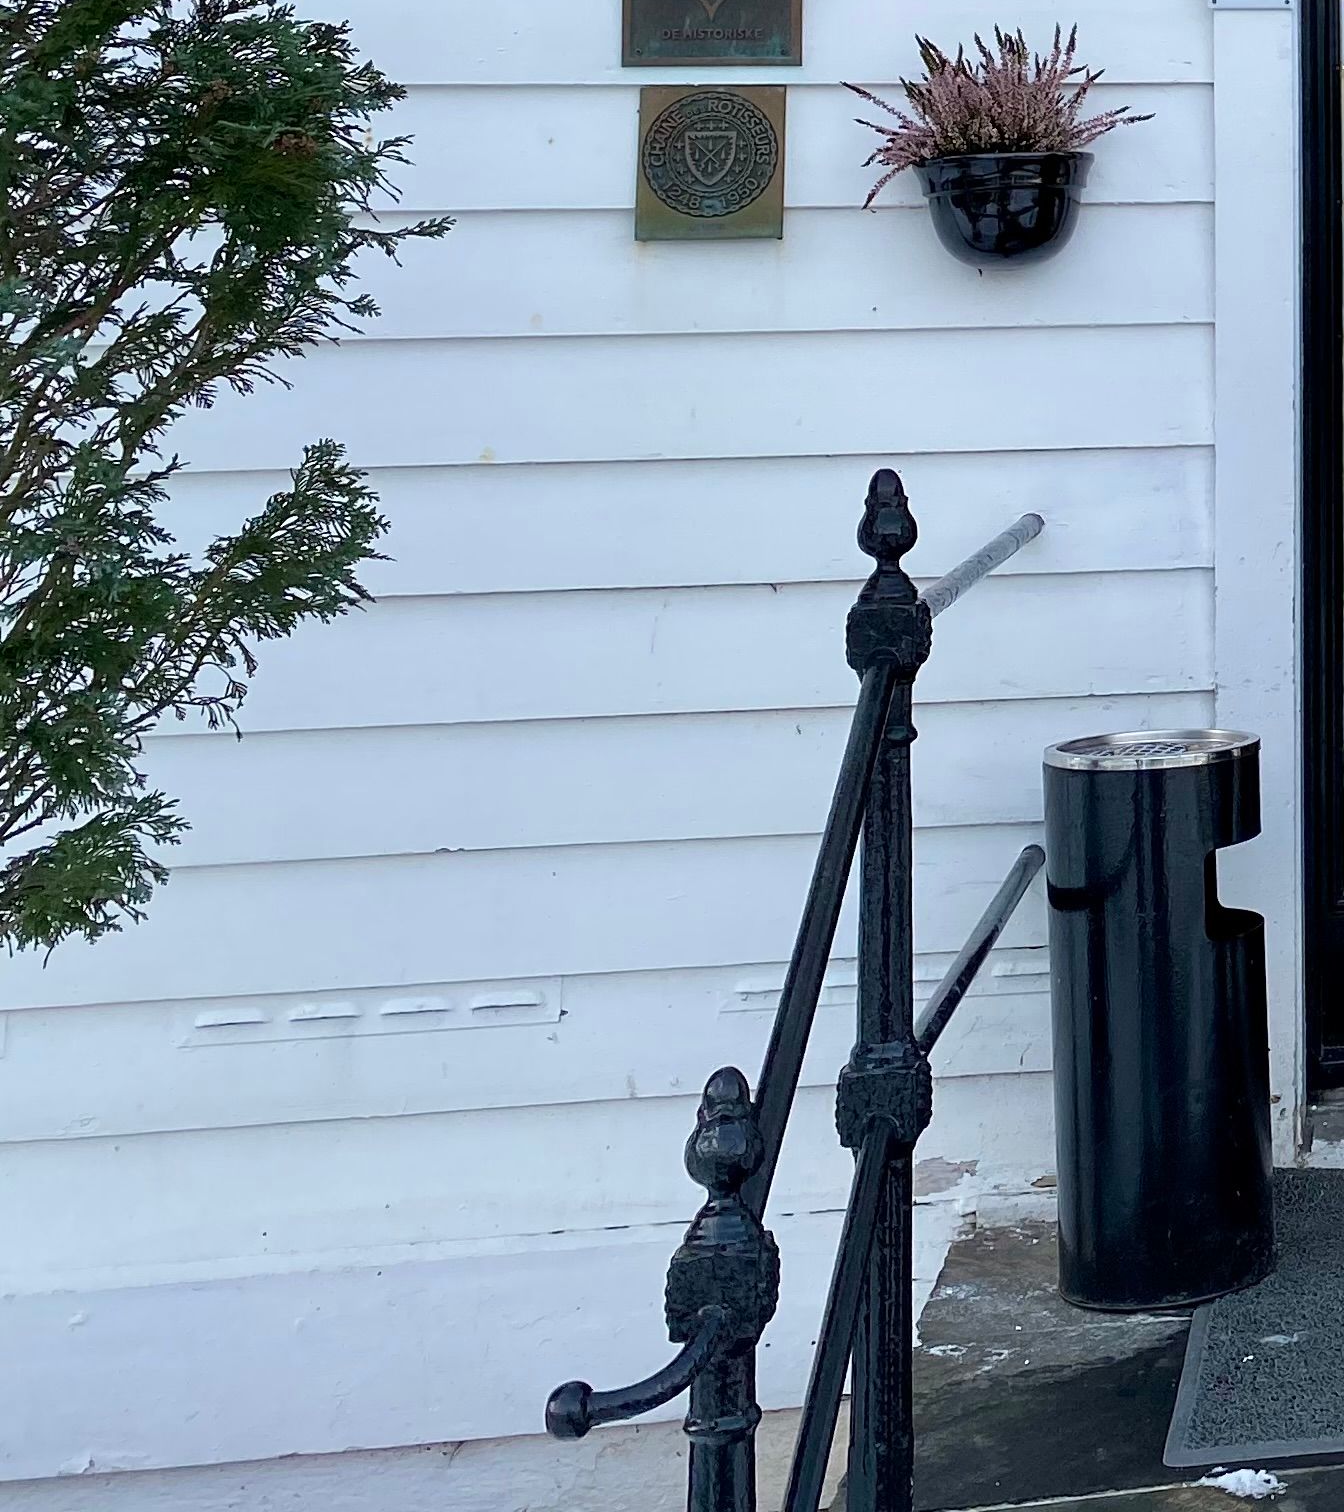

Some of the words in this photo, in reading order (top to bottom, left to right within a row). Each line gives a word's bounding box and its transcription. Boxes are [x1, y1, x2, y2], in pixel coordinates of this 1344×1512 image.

[662, 28, 679, 39] DE
[683, 28, 764, 40] HISTORISKE
[661, 182, 701, 208] 1248
